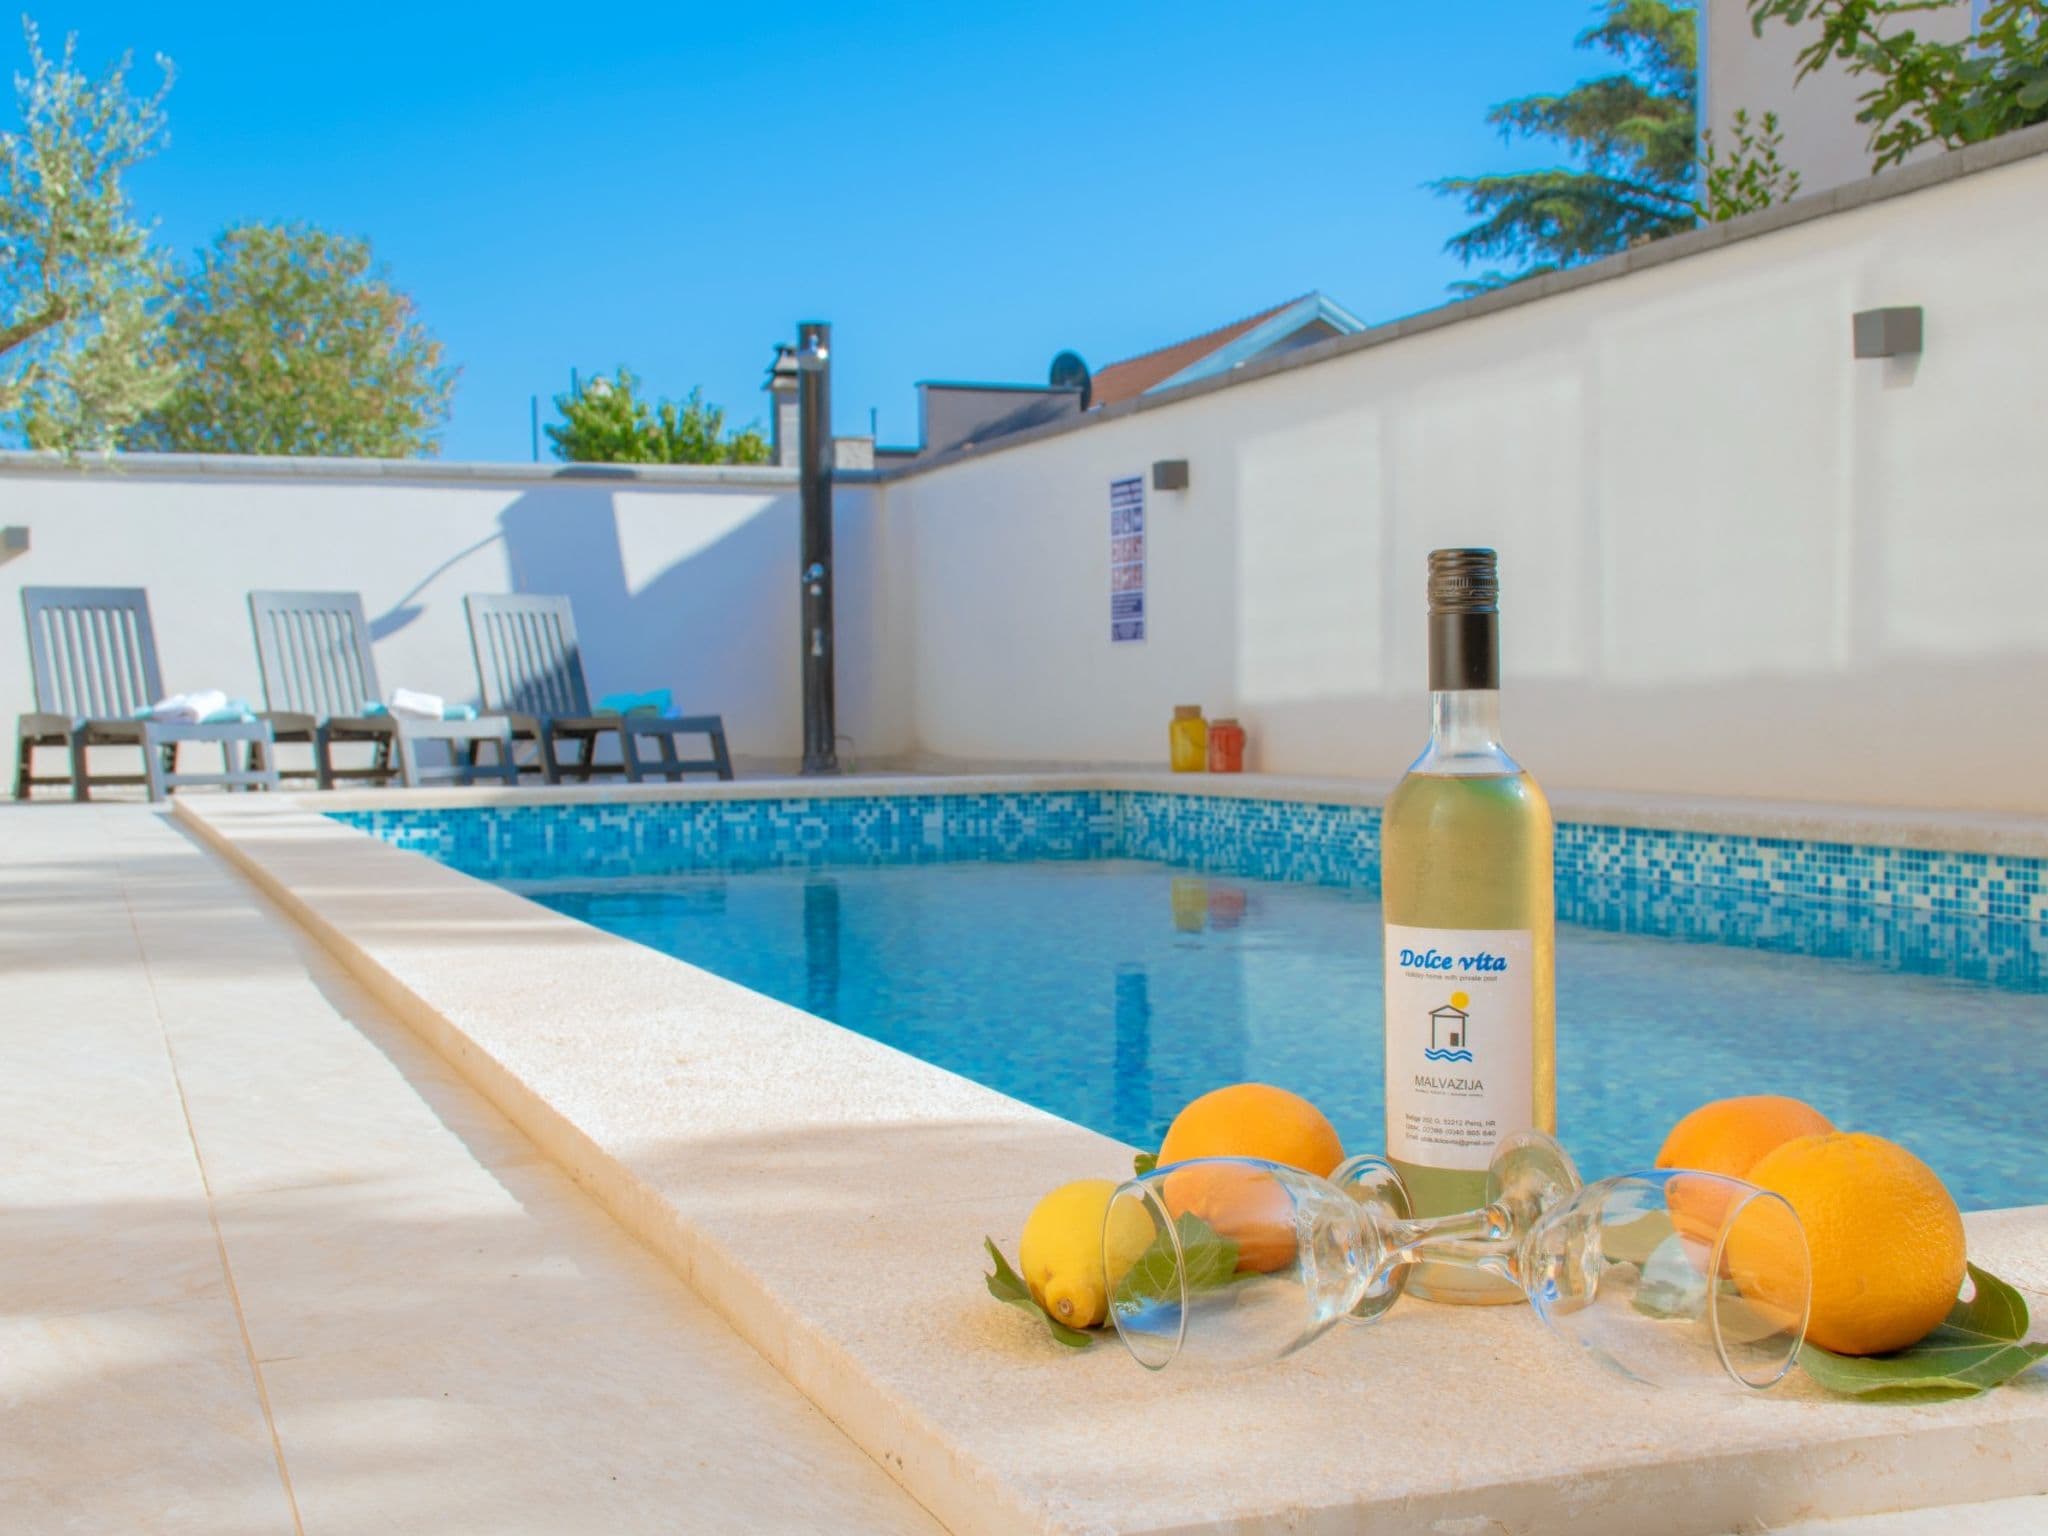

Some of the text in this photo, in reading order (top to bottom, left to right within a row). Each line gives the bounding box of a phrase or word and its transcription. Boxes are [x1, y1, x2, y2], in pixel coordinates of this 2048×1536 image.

[1400, 949, 1507, 971] Dolce vita
[1415, 1075, 1484, 1091] MALVAZIJA
